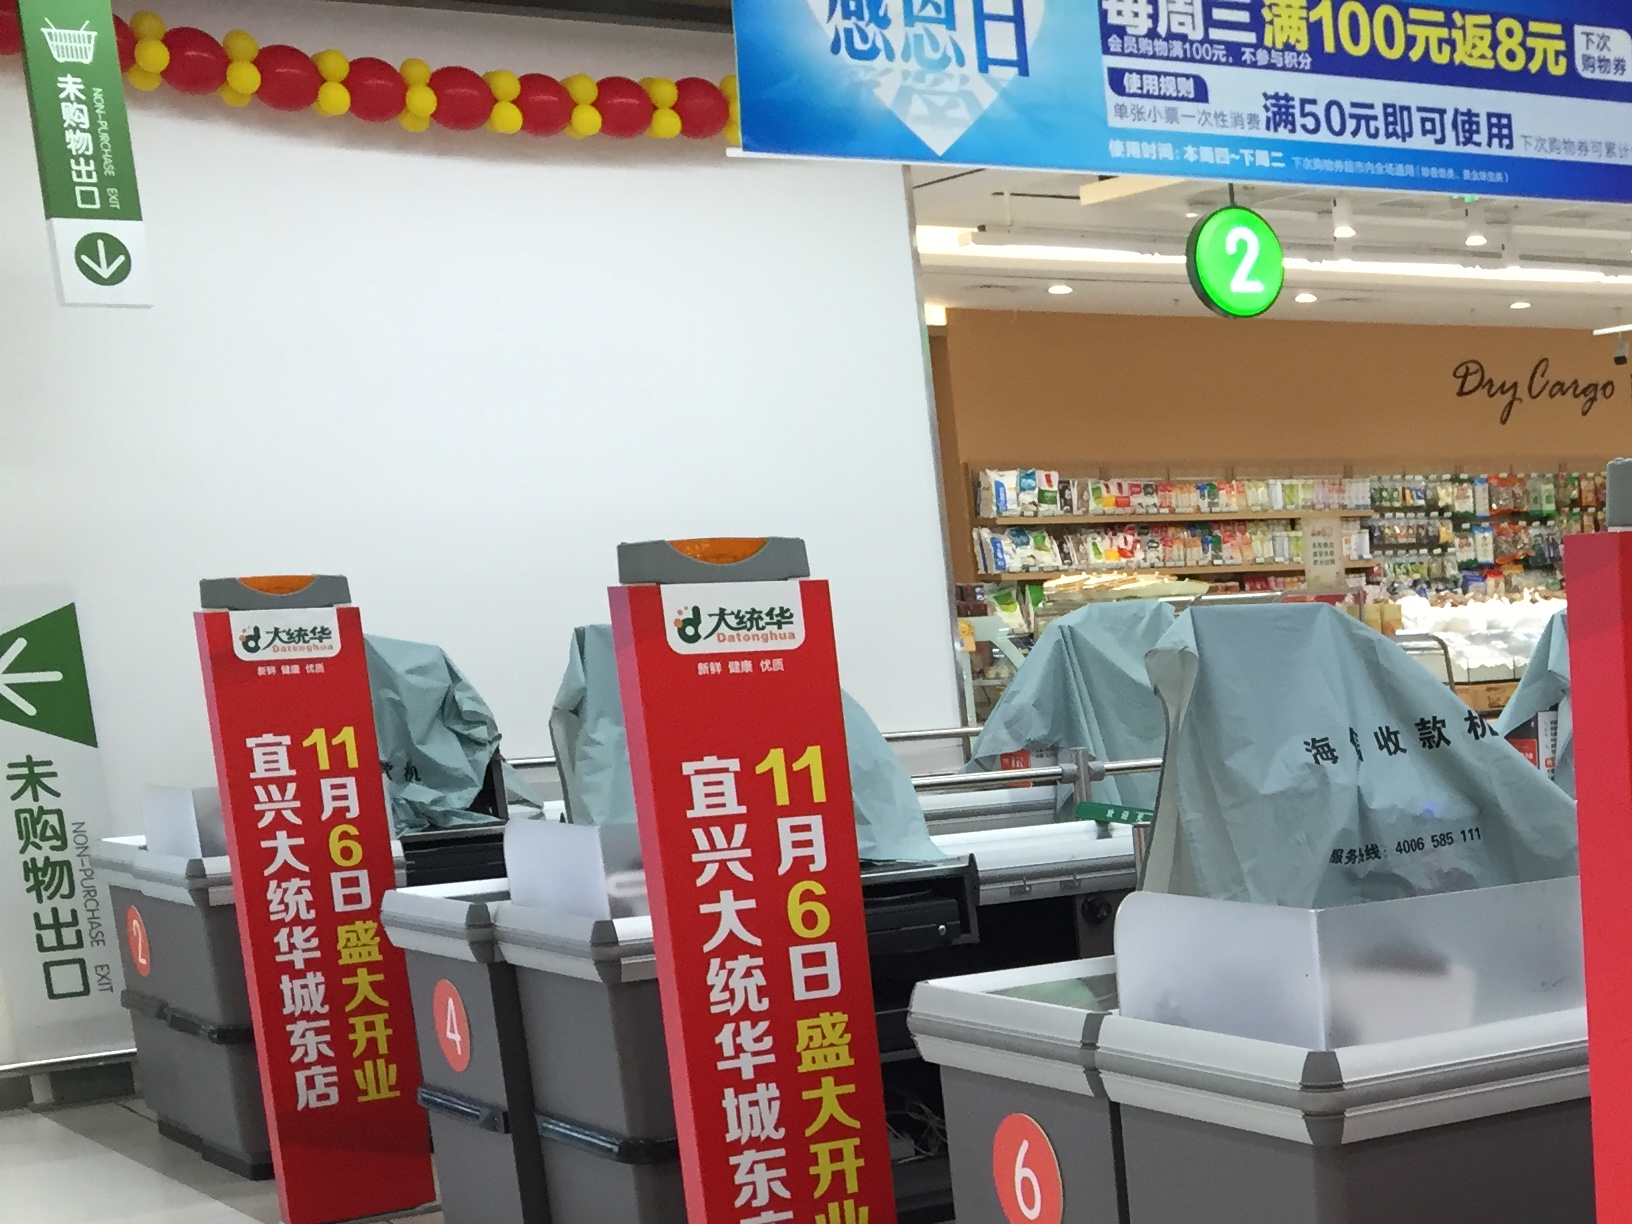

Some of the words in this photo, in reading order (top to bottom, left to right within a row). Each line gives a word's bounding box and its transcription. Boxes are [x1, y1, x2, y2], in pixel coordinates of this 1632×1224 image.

[1581, 31, 1611, 52] 下次
[1123, 71, 1195, 99] 使用规则
[56, 73, 101, 209] 未购物出口
[106, 187, 120, 210] EXIT
[1225, 227, 1265, 293] 2
[1452, 359, 1523, 425] Dry
[1527, 357, 1615, 416] Cargo
[262, 625, 333, 651] 大统华
[703, 606, 794, 641] 大统华
[716, 630, 796, 643] Datonghua
[1395, 836, 1425, 855] 4006
[1431, 831, 1455, 849] 585
[1460, 827, 1482, 843] 111
[6, 754, 91, 1001] 未购物出口
[71, 820, 106, 947] NON-PURCHASE
[94, 963, 115, 994] EXIT
[132, 919, 148, 966] 2
[245, 732, 340, 1111] 宜兴大统华城东店
[303, 725, 401, 1103] 11月6日盛大开业
[446, 996, 462, 1056] 4
[1014, 1139, 1042, 1221] 6
